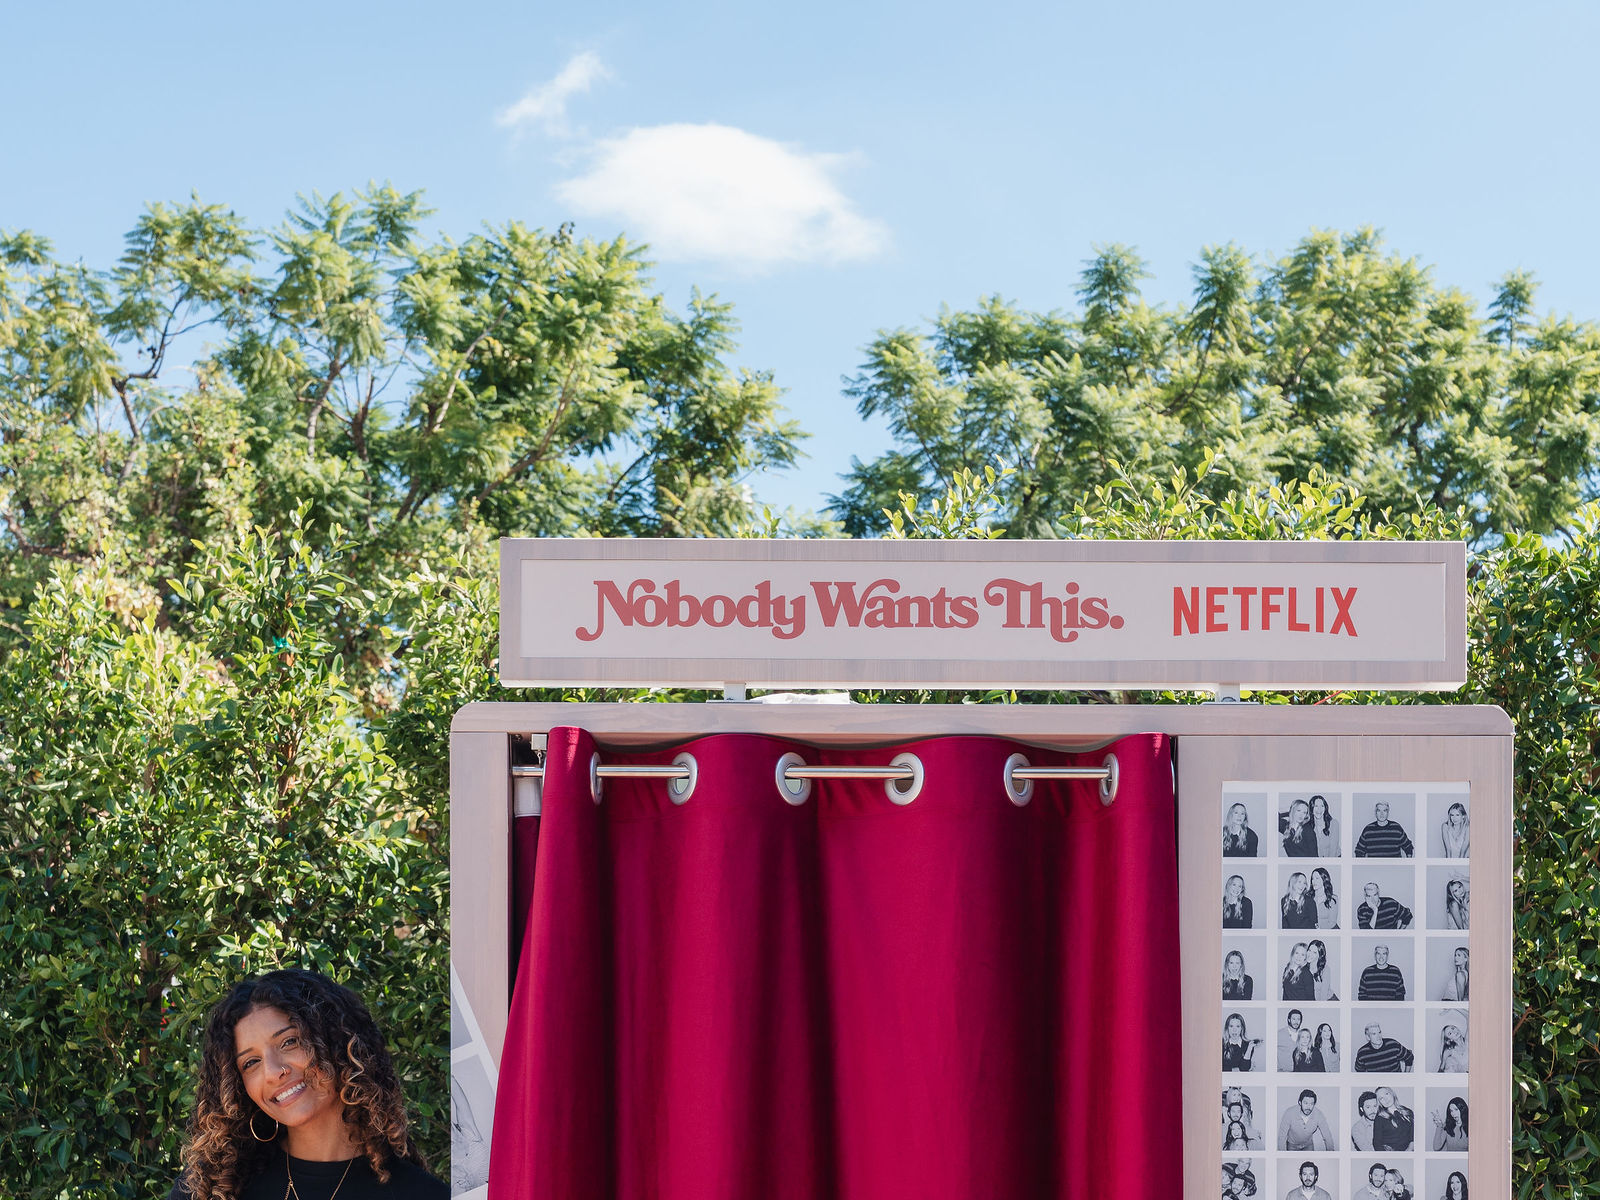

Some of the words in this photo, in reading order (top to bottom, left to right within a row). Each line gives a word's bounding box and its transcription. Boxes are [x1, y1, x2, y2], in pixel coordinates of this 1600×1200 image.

[575, 578, 806, 642] Nobody
[810, 578, 979, 629] Wants
[983, 578, 1125, 643] This.
[1173, 586, 1358, 638] NETFLIX
